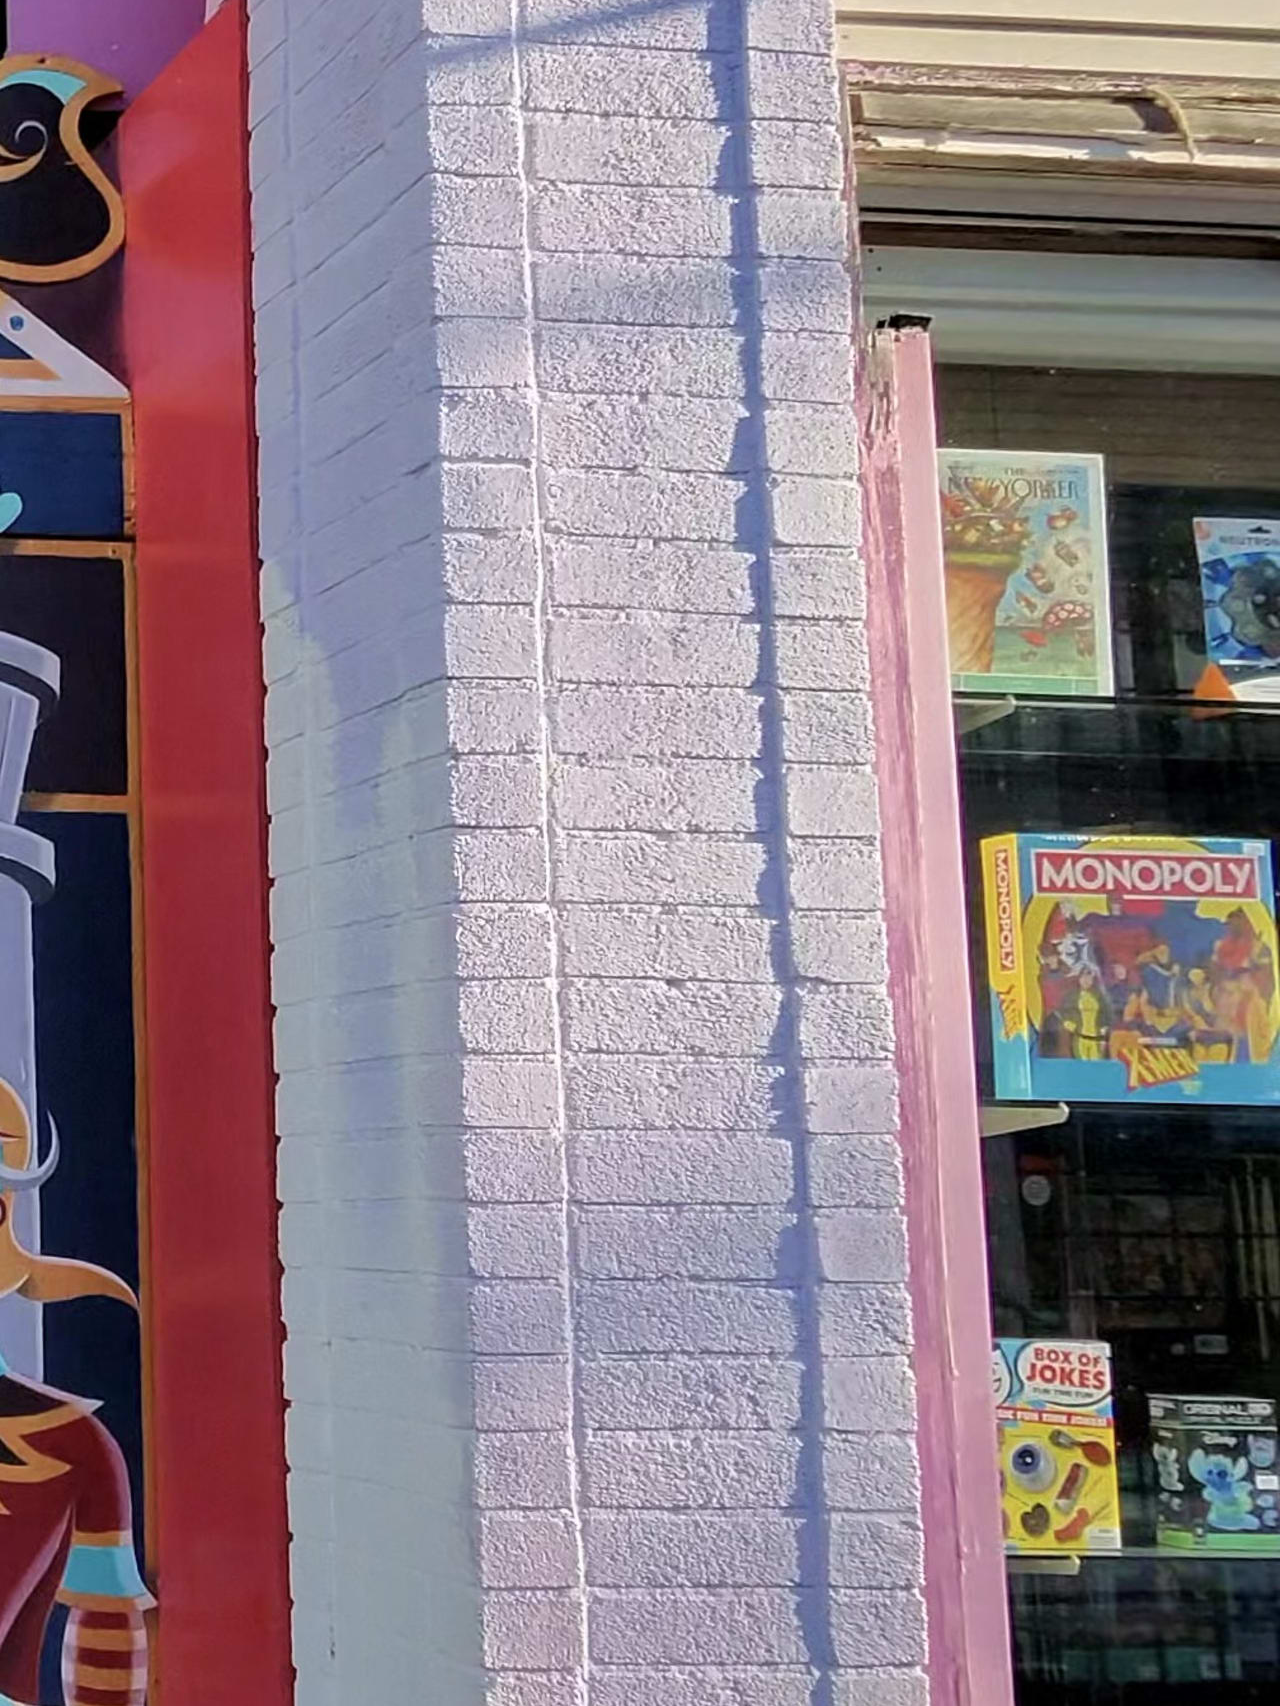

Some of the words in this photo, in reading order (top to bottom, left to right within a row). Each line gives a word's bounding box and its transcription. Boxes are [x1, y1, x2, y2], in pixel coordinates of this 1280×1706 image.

[1041, 857, 1251, 893] MONOPOLY
[996, 850, 1015, 970] MONOPOLY
[1034, 1348, 1072, 1365] BOX
[1078, 1353, 1102, 1369] OF
[1026, 1363, 1106, 1391] JOKES
